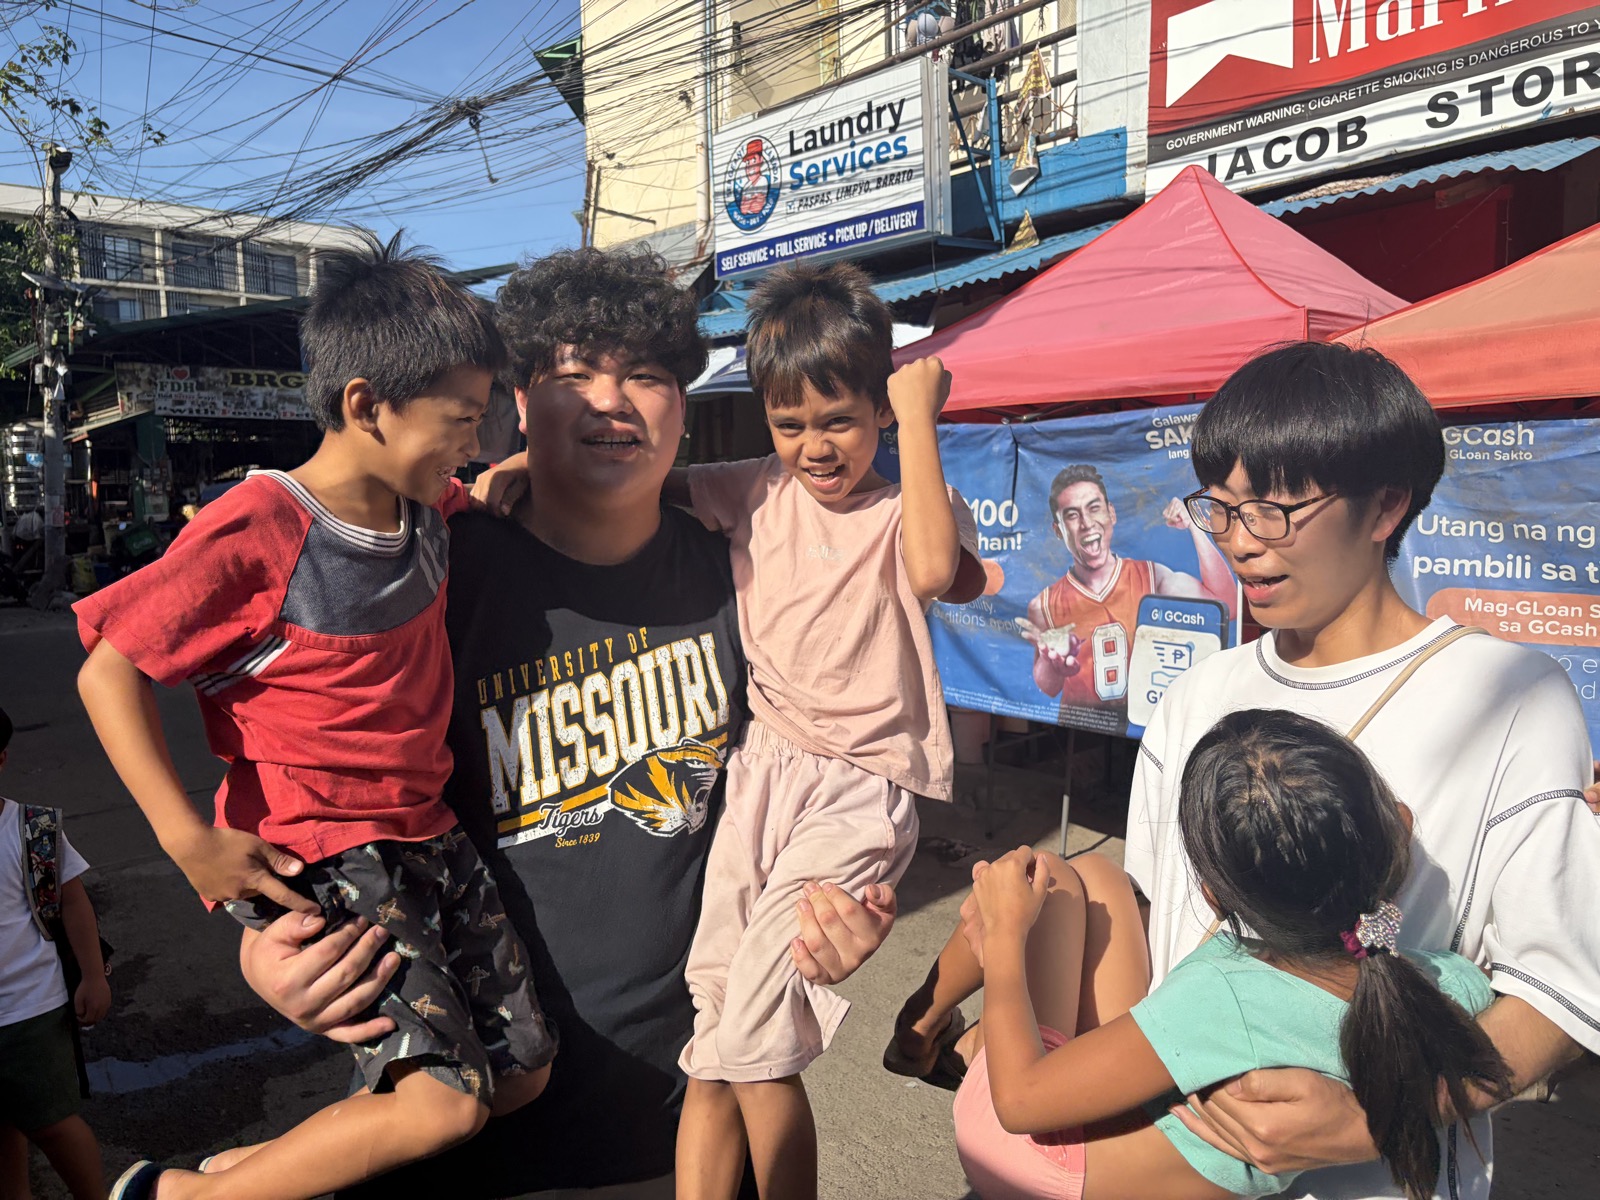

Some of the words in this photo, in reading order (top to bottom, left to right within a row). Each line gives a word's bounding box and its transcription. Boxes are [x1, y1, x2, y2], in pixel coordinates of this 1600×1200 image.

[1166, 120, 1243, 151] GOVERNMENT
[1245, 102, 1305, 129] WARNING:
[1308, 82, 1380, 112] CIGARETTE
[1383, 62, 1447, 90] SMOKING
[1451, 58, 1465, 71] IS
[1468, 28, 1563, 67] DANGEROUS
[1567, 22, 1589, 37] TO
[1425, 51, 1600, 129] STOR
[789, 98, 906, 157] Laundry
[789, 135, 909, 191] Services
[797, 190, 833, 212] PASPAS,
[835, 180, 873, 201] LIMPYO,
[875, 169, 914, 190] BARATO
[721, 254, 738, 271] SELF
[738, 246, 768, 267] SERVICE
[775, 238, 794, 258] FULL
[793, 233, 827, 254] SERVICE
[835, 226, 855, 243] PICK
[855, 222, 868, 239] UP
[874, 209, 918, 235] DELIVERY
[157, 381, 197, 393] FDH
[230, 371, 309, 389] BRG
[1443, 424, 1535, 446] GCash
[1168, 449, 1190, 460] lang
[1449, 449, 1490, 460] GLoan
[1493, 449, 1533, 461] Sakto
[1417, 514, 1505, 543] Utang
[1512, 523, 1547, 541] na
[1556, 524, 1596, 549] ng
[1413, 554, 1531, 580] pambili
[1541, 562, 1577, 582] sa
[1164, 610, 1205, 626] GCash
[1464, 597, 1582, 617] Mag-GLoan
[1499, 621, 1521, 632] sa
[1528, 620, 1597, 637] GCash
[477, 637, 613, 705] UNIVERSITY
[627, 626, 649, 654] OF
[480, 632, 729, 815] MISSOURI
[537, 802, 603, 836] Tigers
[555, 836, 577, 848] Since
[579, 832, 600, 845] 1839
